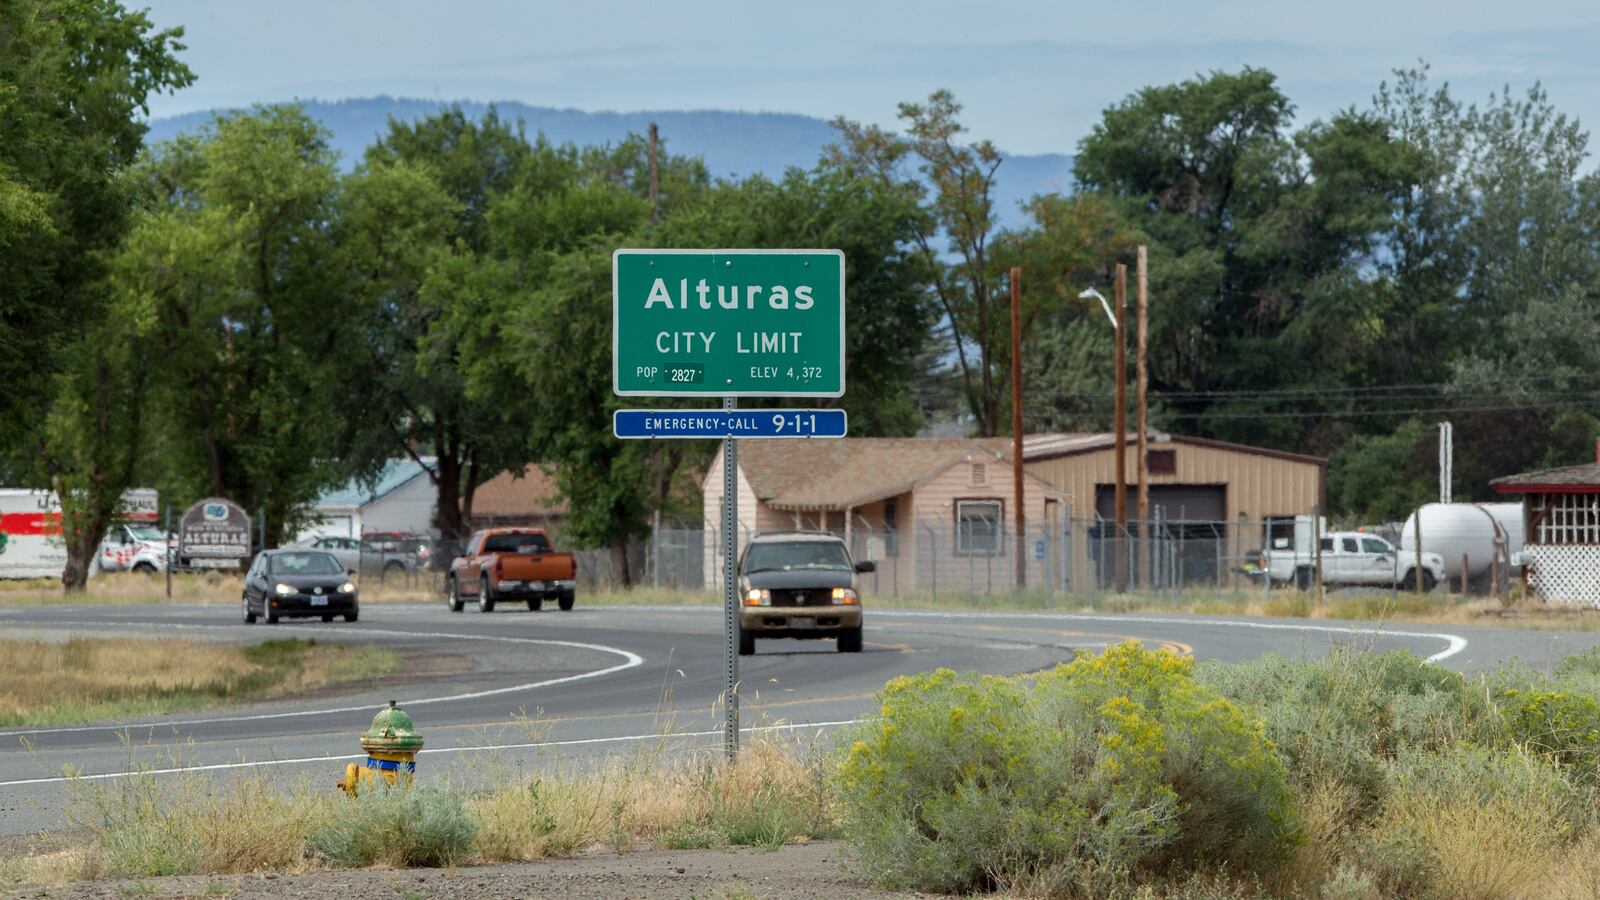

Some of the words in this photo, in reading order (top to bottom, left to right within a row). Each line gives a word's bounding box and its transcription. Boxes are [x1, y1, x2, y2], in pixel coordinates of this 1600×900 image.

[644, 277, 815, 310] Alturas
[656, 331, 716, 354] CITY
[737, 332, 802, 354] LIMIT
[636, 367, 658, 378] POP
[671, 368, 695, 382] 2827
[750, 367, 778, 378] ELEV
[787, 367, 822, 381] 4,372
[645, 418, 758, 430] EMERGENCY-CALL
[772, 414, 816, 433] 9-1-1
